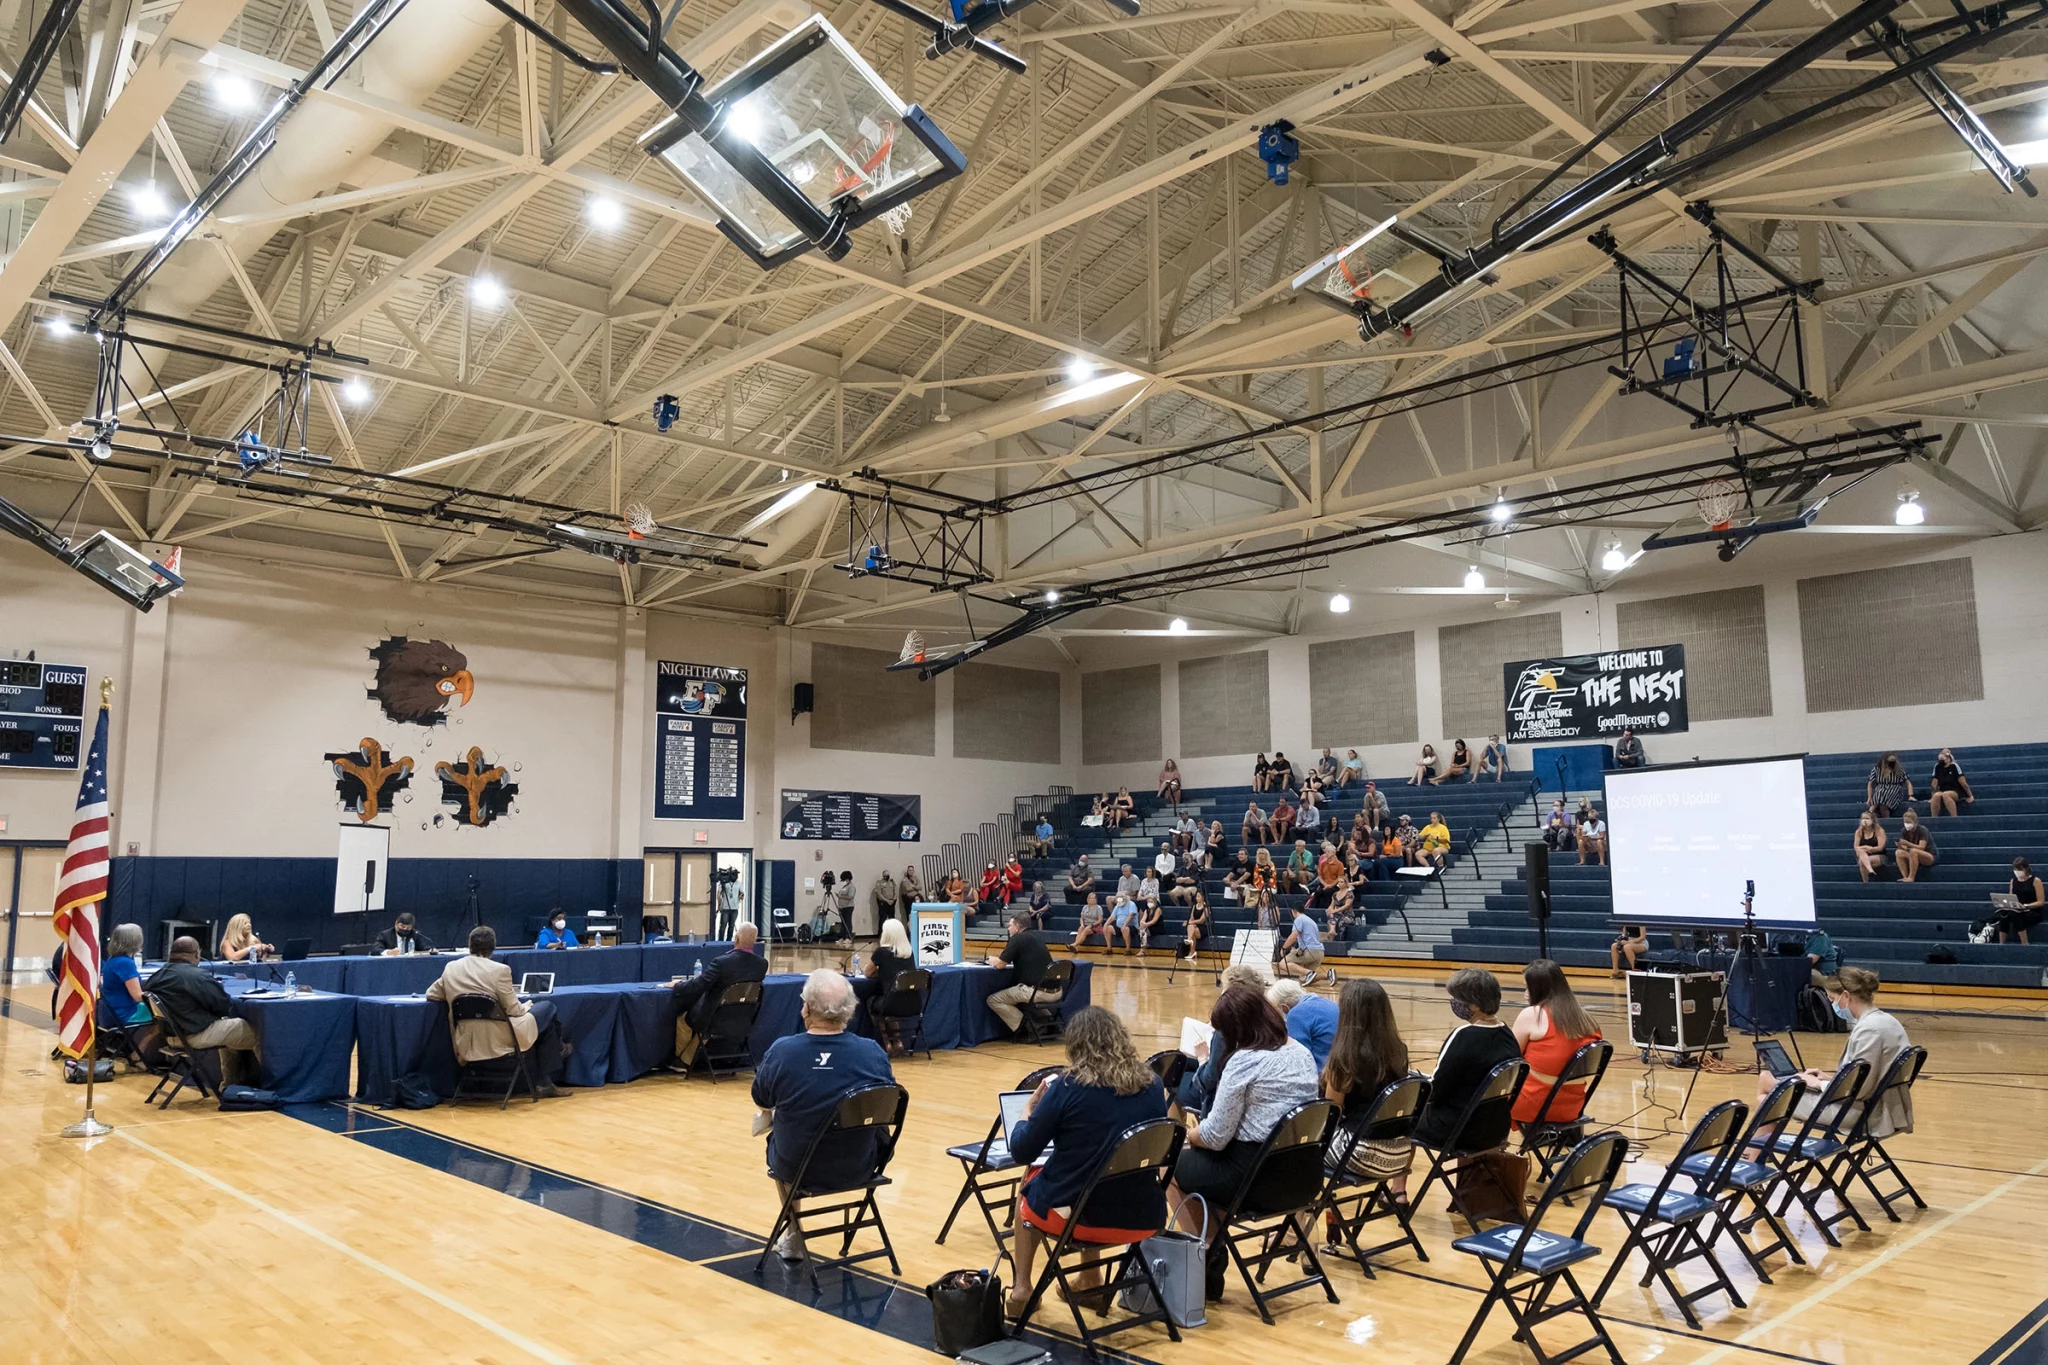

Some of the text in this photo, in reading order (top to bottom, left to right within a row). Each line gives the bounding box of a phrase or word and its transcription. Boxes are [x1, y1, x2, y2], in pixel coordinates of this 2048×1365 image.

[1598, 650, 1664, 672] WELCOME TO
[46, 672, 85, 684] GUEST
[659, 662, 747, 682] NIGHTHAWKS
[1581, 669, 1684, 707] THE NEST
[35, 706, 62, 714] BONUS
[1514, 708, 1573, 721] COACH BILL PRINCE
[53, 724, 80, 732] FOULS
[1508, 727, 1581, 740] I AM SOMEBODY
[54, 755, 75, 763] WON
[1631, 793, 1679, 808] COVID-19
[1682, 791, 1721, 808] Update
[920, 929, 951, 938] FLIGHT
